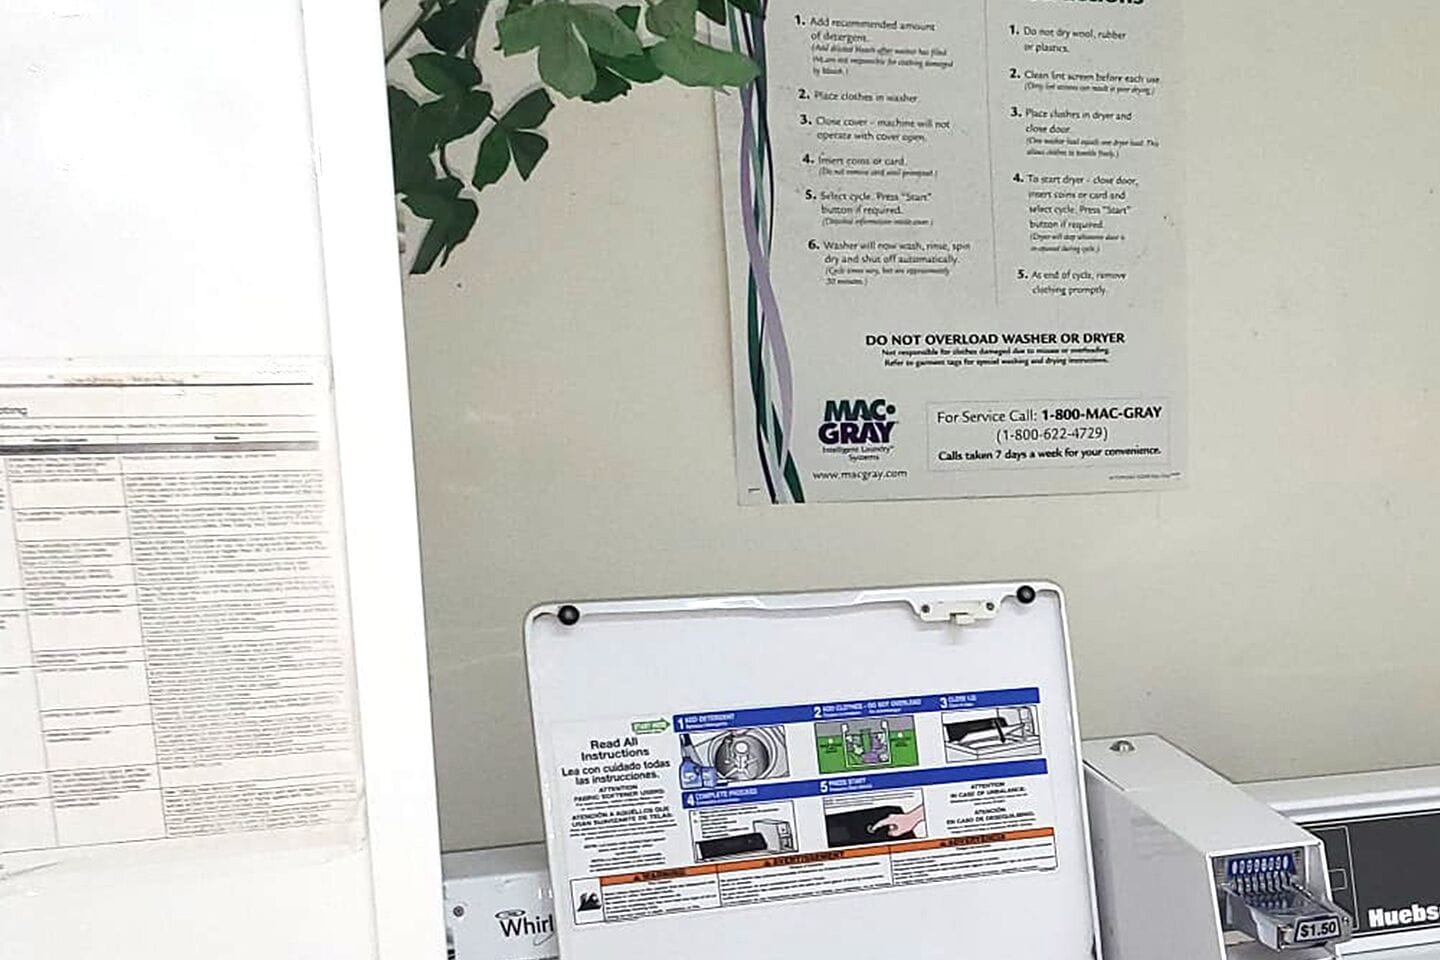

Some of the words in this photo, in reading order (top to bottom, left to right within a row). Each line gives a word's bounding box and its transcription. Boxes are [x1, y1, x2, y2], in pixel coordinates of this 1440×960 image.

[794, 14, 806, 26] 1.
[810, 17, 829, 27] Add
[831, 19, 898, 30] recommended
[900, 23, 936, 32] amount
[811, 32, 821, 41] of
[1009, 25, 1020, 35] 1.
[1024, 26, 1037, 36] Do
[1039, 28, 1054, 37] not
[1056, 28, 1070, 39] dry
[1072, 29, 1096, 39] wool,
[1098, 30, 1126, 40] rubber
[1009, 68, 1020, 79] 2.
[1024, 70, 1049, 80] Clean
[1051, 71, 1065, 80] lint
[1067, 72, 1094, 81] screen
[1096, 73, 1122, 82] before
[1124, 74, 1144, 83] each
[798, 89, 810, 100] 2.
[814, 91, 839, 101] Place
[841, 91, 873, 102] clothes
[876, 92, 884, 101] in
[1010, 106, 1022, 117] 3.
[1025, 108, 1048, 118] Place
[1050, 109, 1080, 120] clothes
[1082, 110, 1091, 119] in
[1092, 111, 1114, 121] dryer
[1115, 111, 1132, 120] and
[800, 114, 812, 125] 3.
[816, 116, 841, 126] Close
[843, 119, 867, 127] cover
[877, 117, 914, 128] machine
[917, 118, 933, 128] will
[935, 119, 950, 129] not
[1025, 124, 1047, 133] close
[817, 132, 851, 142] operate
[854, 132, 875, 140] with
[876, 133, 900, 141] cover
[802, 154, 815, 164] 4.
[818, 156, 844, 165] Insert
[846, 156, 870, 165] coins
[1013, 173, 1024, 183] 4.
[1026, 174, 1039, 183] To
[1041, 175, 1061, 183] start
[1062, 174, 1084, 186] dryer
[1093, 175, 1113, 184] close
[1115, 176, 1139, 186] door,
[805, 189, 817, 200] 5.
[821, 192, 846, 201] Select
[877, 192, 899, 201] Press
[1028, 190, 1051, 199] insert
[1053, 191, 1076, 199] coins
[1089, 190, 1107, 200] card
[1110, 191, 1126, 200] and
[821, 205, 853, 215] button
[855, 205, 862, 215] if
[1029, 205, 1052, 214] select
[1079, 205, 1100, 214] Press
[1029, 220, 1059, 229] button
[1060, 220, 1067, 229] if
[808, 239, 820, 250] 6.
[823, 240, 858, 250] Washer
[860, 240, 876, 250] will
[900, 241, 925, 251] wash,
[825, 255, 839, 265] dry
[841, 255, 859, 264] and
[861, 255, 881, 263] shut
[883, 255, 897, 263] off
[1017, 269, 1028, 280] 5.
[1044, 271, 1059, 280] end
[1061, 270, 1071, 279] of
[1032, 285, 1067, 296] clothing
[864, 335, 888, 345] DO
[891, 335, 921, 345] NOT
[925, 334, 999, 345] OVERLOAD
[1001, 333, 1057, 344] WASHER
[1060, 333, 1080, 344] OR
[1083, 332, 1126, 343] DRYER
[937, 411, 959, 423] For
[962, 409, 1005, 423] Service
[1008, 408, 1037, 421] Call:
[1041, 406, 1162, 420] 1-800-MAC-GRAY
[818, 421, 896, 445] GRAY
[996, 426, 1108, 445] (1-800-622-4729)
[848, 454, 880, 462] Systems
[938, 450, 963, 461] Calls
[965, 450, 993, 460] taken
[996, 450, 1002, 459] 7
[1004, 448, 1027, 461] days
[1037, 447, 1062, 458] week
[1064, 447, 1079, 457] for
[1081, 449, 1102, 459] your
[812, 470, 908, 481] www.macgray.com
[678, 718, 684, 730] 1
[813, 706, 822, 718] 2
[940, 697, 948, 708] 3
[590, 738, 620, 750] Read
[623, 737, 638, 747] All
[581, 748, 650, 761] Instructions
[561, 767, 580, 777] Lea
[582, 766, 601, 775] con
[602, 762, 641, 773] cuidado
[643, 759, 671, 770] todas
[575, 776, 590, 786] las
[592, 771, 661, 784] instrucciones.
[687, 794, 695, 806] 4
[820, 780, 828, 793] 5
[500, 914, 554, 937] Whirl
[1299, 920, 1337, 938] $1.50
